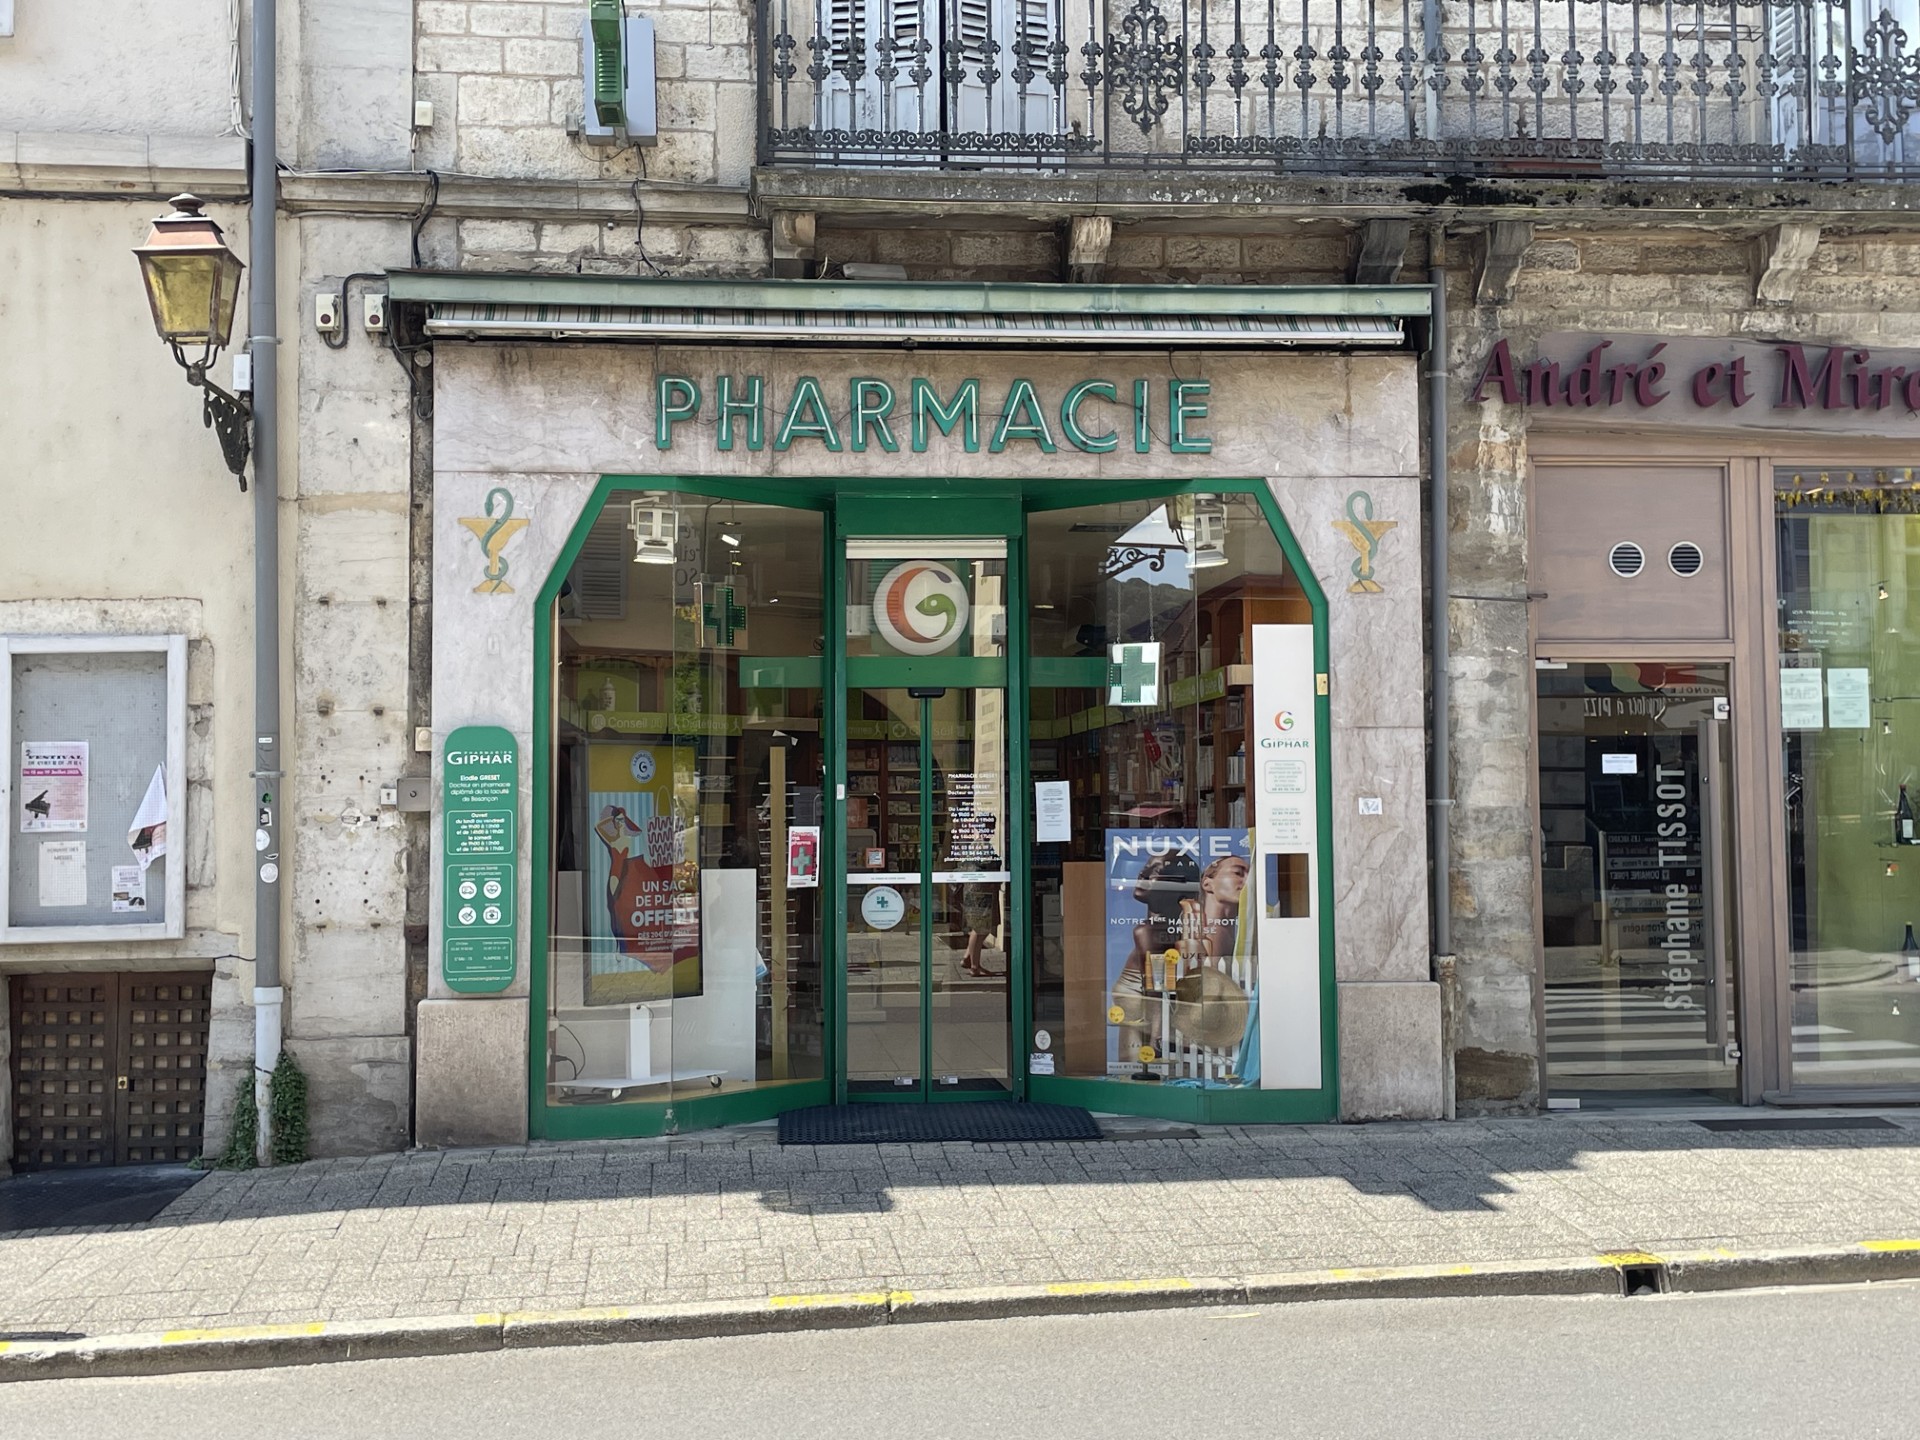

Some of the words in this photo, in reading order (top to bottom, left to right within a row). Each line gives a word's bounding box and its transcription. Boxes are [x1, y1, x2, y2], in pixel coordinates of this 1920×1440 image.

[1472, 338, 1671, 408] André
[1693, 355, 1756, 409] et
[656, 375, 1212, 454] PHARMACIE
[1261, 738, 1309, 748] GIPHAR
[447, 751, 512, 764] GIPHAR
[1656, 764, 1687, 867] TISSOT
[1113, 836, 1232, 856] NUXE
[642, 881, 659, 892] UN
[662, 880, 686, 891] SAC
[636, 895, 651, 907] DE
[655, 894, 692, 906] PLAGE
[631, 908, 697, 927] OFFERT
[1661, 884, 1698, 1009] Stéphane
